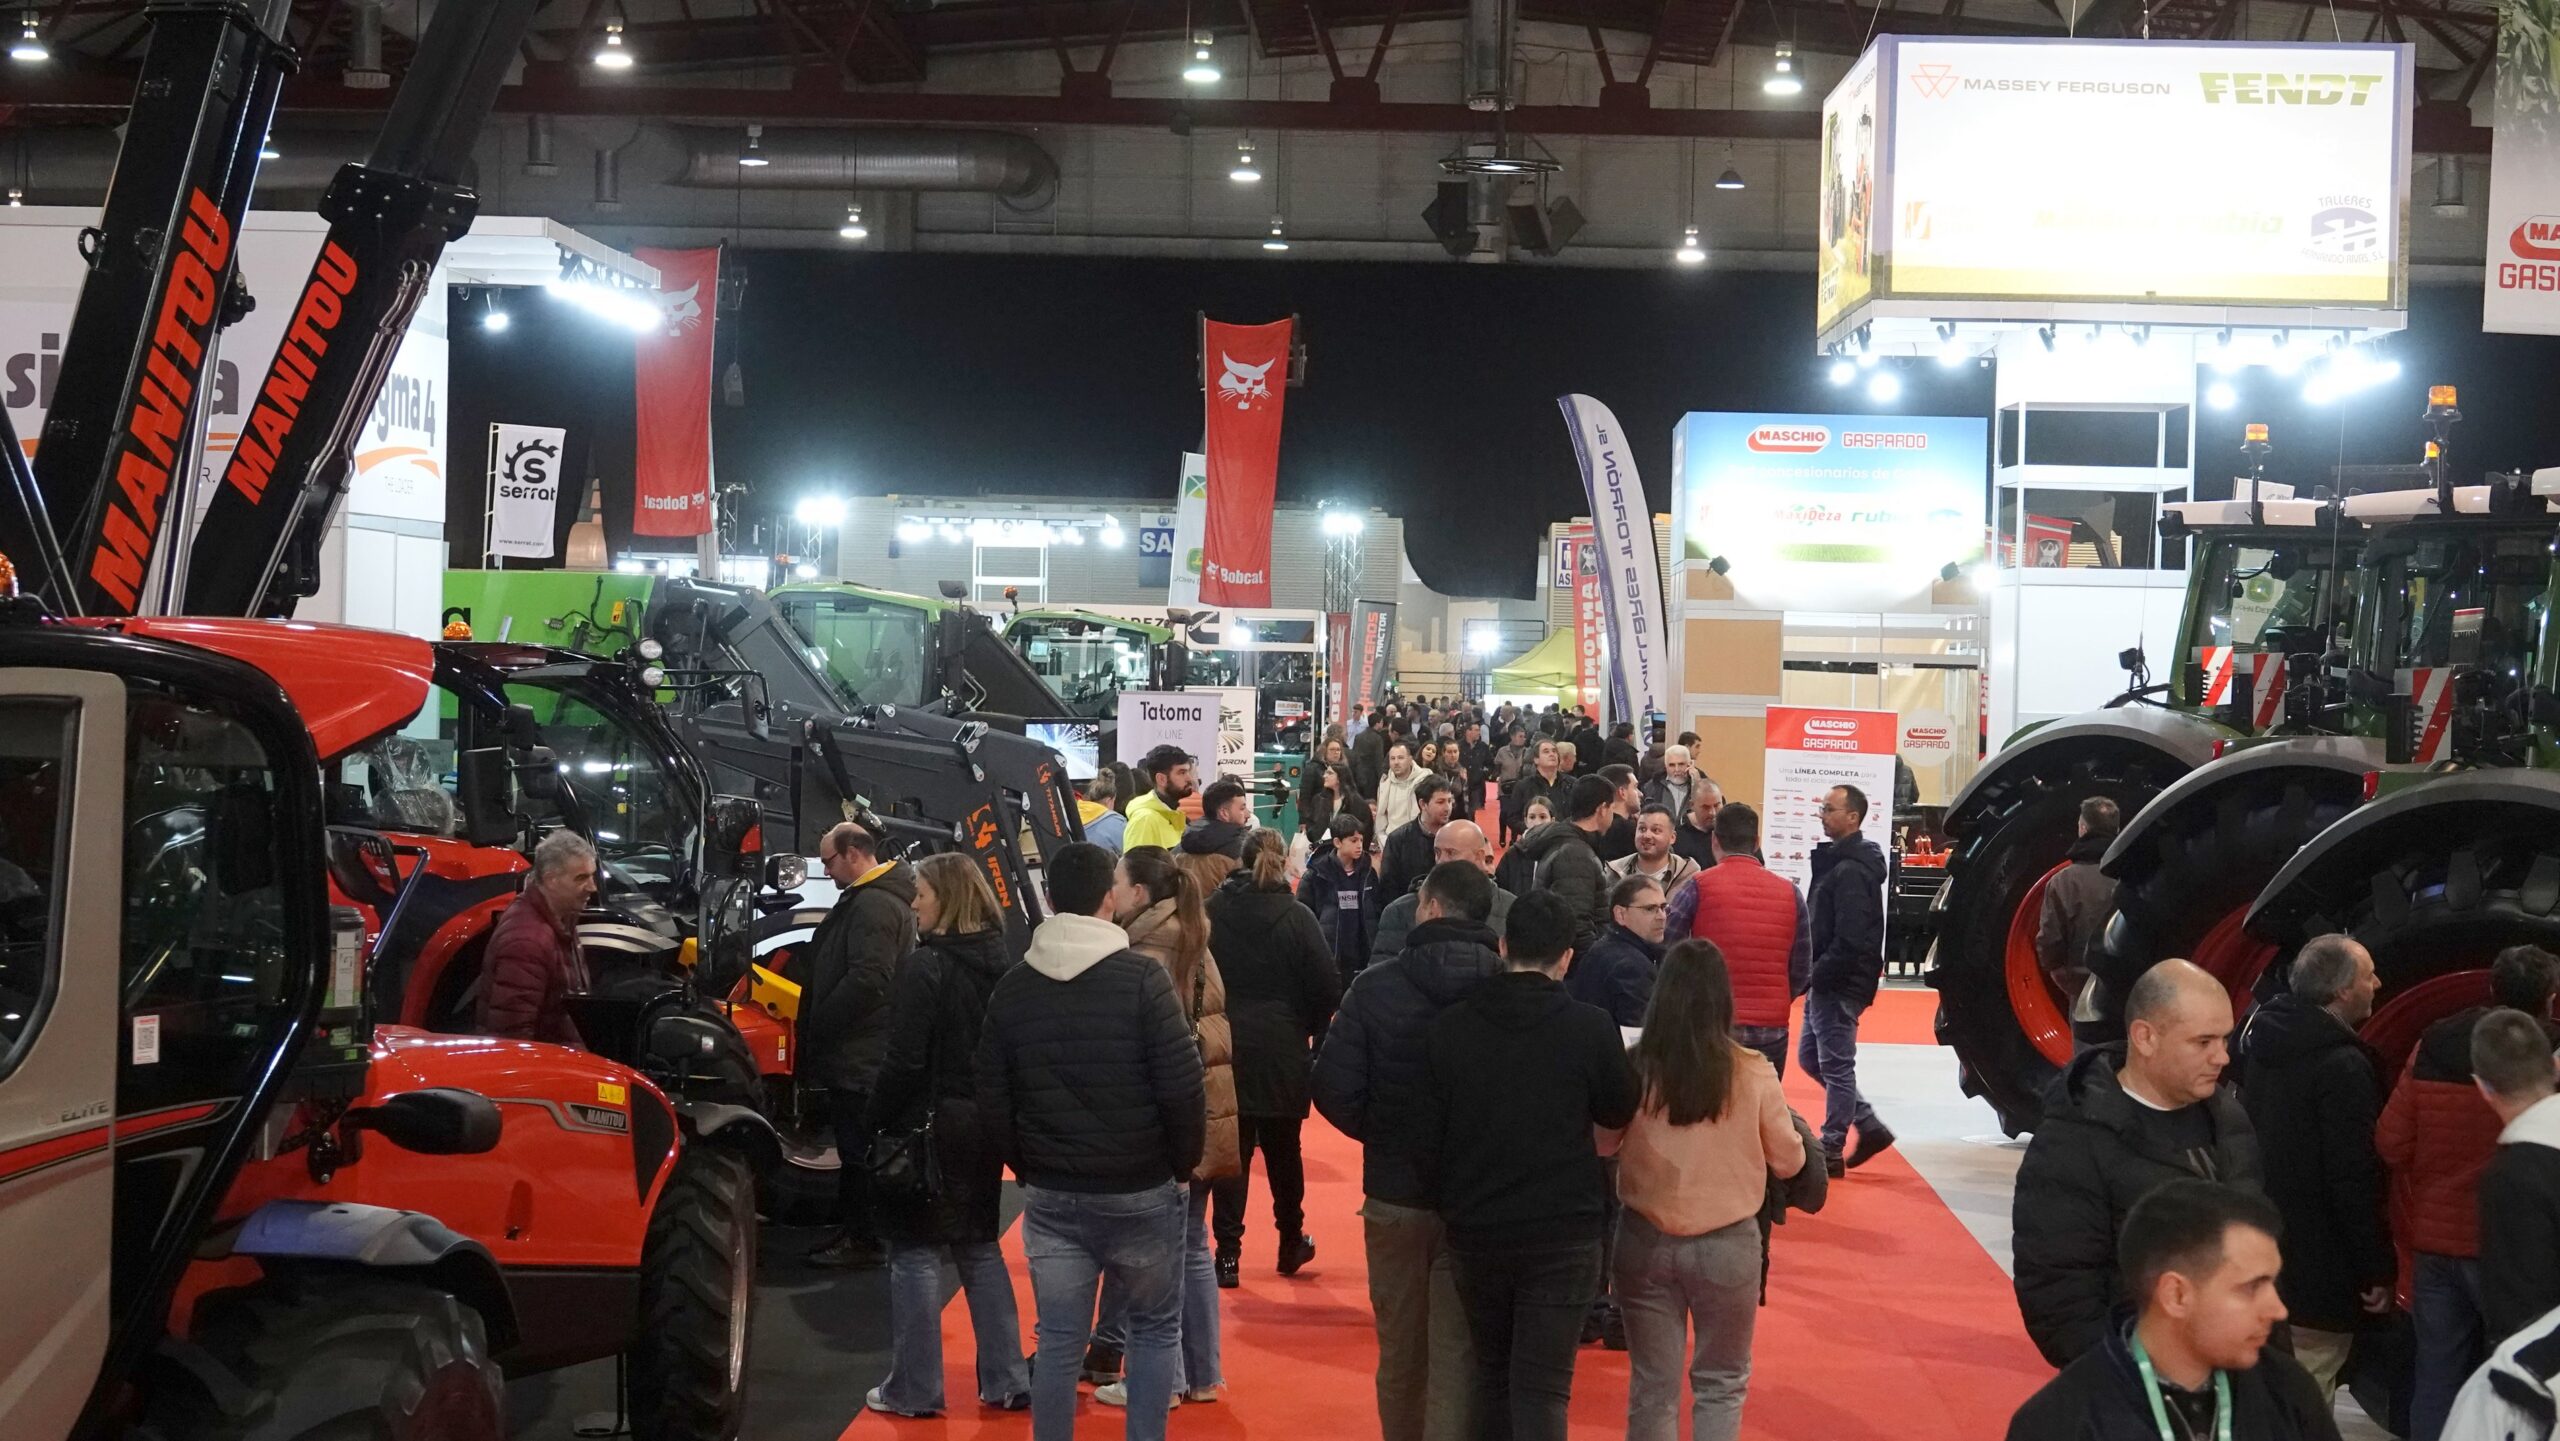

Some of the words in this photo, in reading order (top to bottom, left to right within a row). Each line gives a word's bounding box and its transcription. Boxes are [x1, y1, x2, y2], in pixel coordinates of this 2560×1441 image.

[1964, 77, 2052, 94] MASSEY
[2056, 79, 2171, 96] FERGUSON
[2199, 71, 2384, 107] FENDT
[2318, 194, 2372, 209] TALLERES
[226, 242, 358, 505] MANITOU
[90, 187, 232, 614] MANITOU
[1758, 430, 1826, 443] MASCHIO
[1843, 433, 1927, 449] GASPARDO
[500, 485, 556, 501] serrat
[499, 539, 544, 547] www.serrat.com
[1220, 567, 1263, 585] Bobcat
[1187, 611, 1218, 632] Cummins
[1375, 613, 1387, 659] TRACTOR
[1140, 701, 1202, 722] Tatoma
[1810, 719, 1856, 730] MASCHIO
[1912, 727, 1947, 735] MASCHIO
[1165, 729, 1184, 740] LINE
[1803, 737, 1858, 751] GASPARDO
[1903, 739, 1950, 750] GASPARDO
[1785, 775, 1802, 783] todo
[1795, 767, 1817, 775] LÍNEA
[1818, 769, 1859, 777] COMPLETA
[987, 855, 1012, 908] IRON
[61, 1102, 109, 1122] ELITE
[586, 1109, 625, 1128] MANITOU
